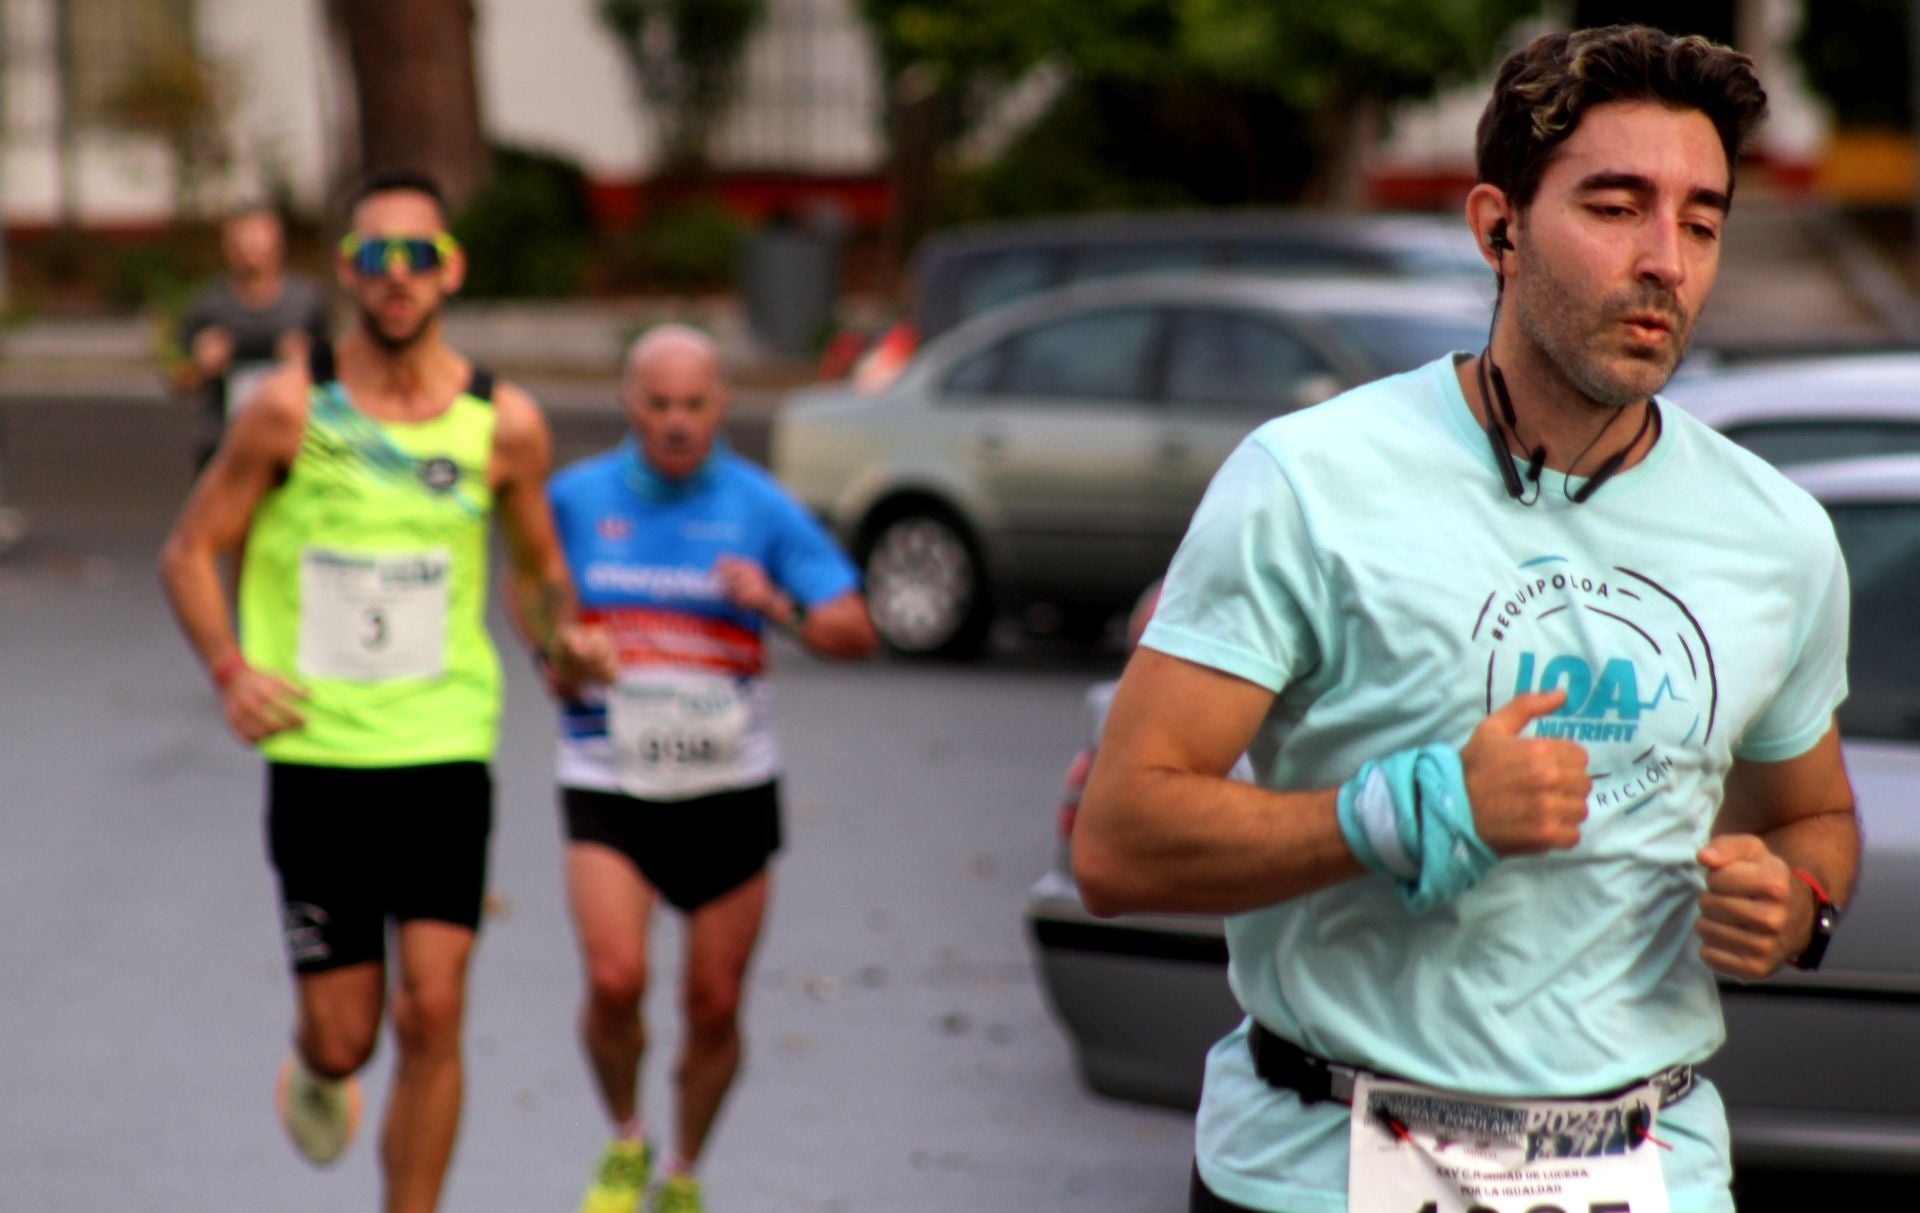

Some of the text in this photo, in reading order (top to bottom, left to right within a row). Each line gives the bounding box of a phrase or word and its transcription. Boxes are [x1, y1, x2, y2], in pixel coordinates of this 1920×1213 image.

[1490, 573, 1609, 642] #EQUIPOLOA
[361, 607, 391, 652] 3
[1534, 718, 1639, 742] NUTRIFIT
[1543, 1168, 1589, 1181] LUCENA
[1502, 1184, 1563, 1197] IGUALDAD
